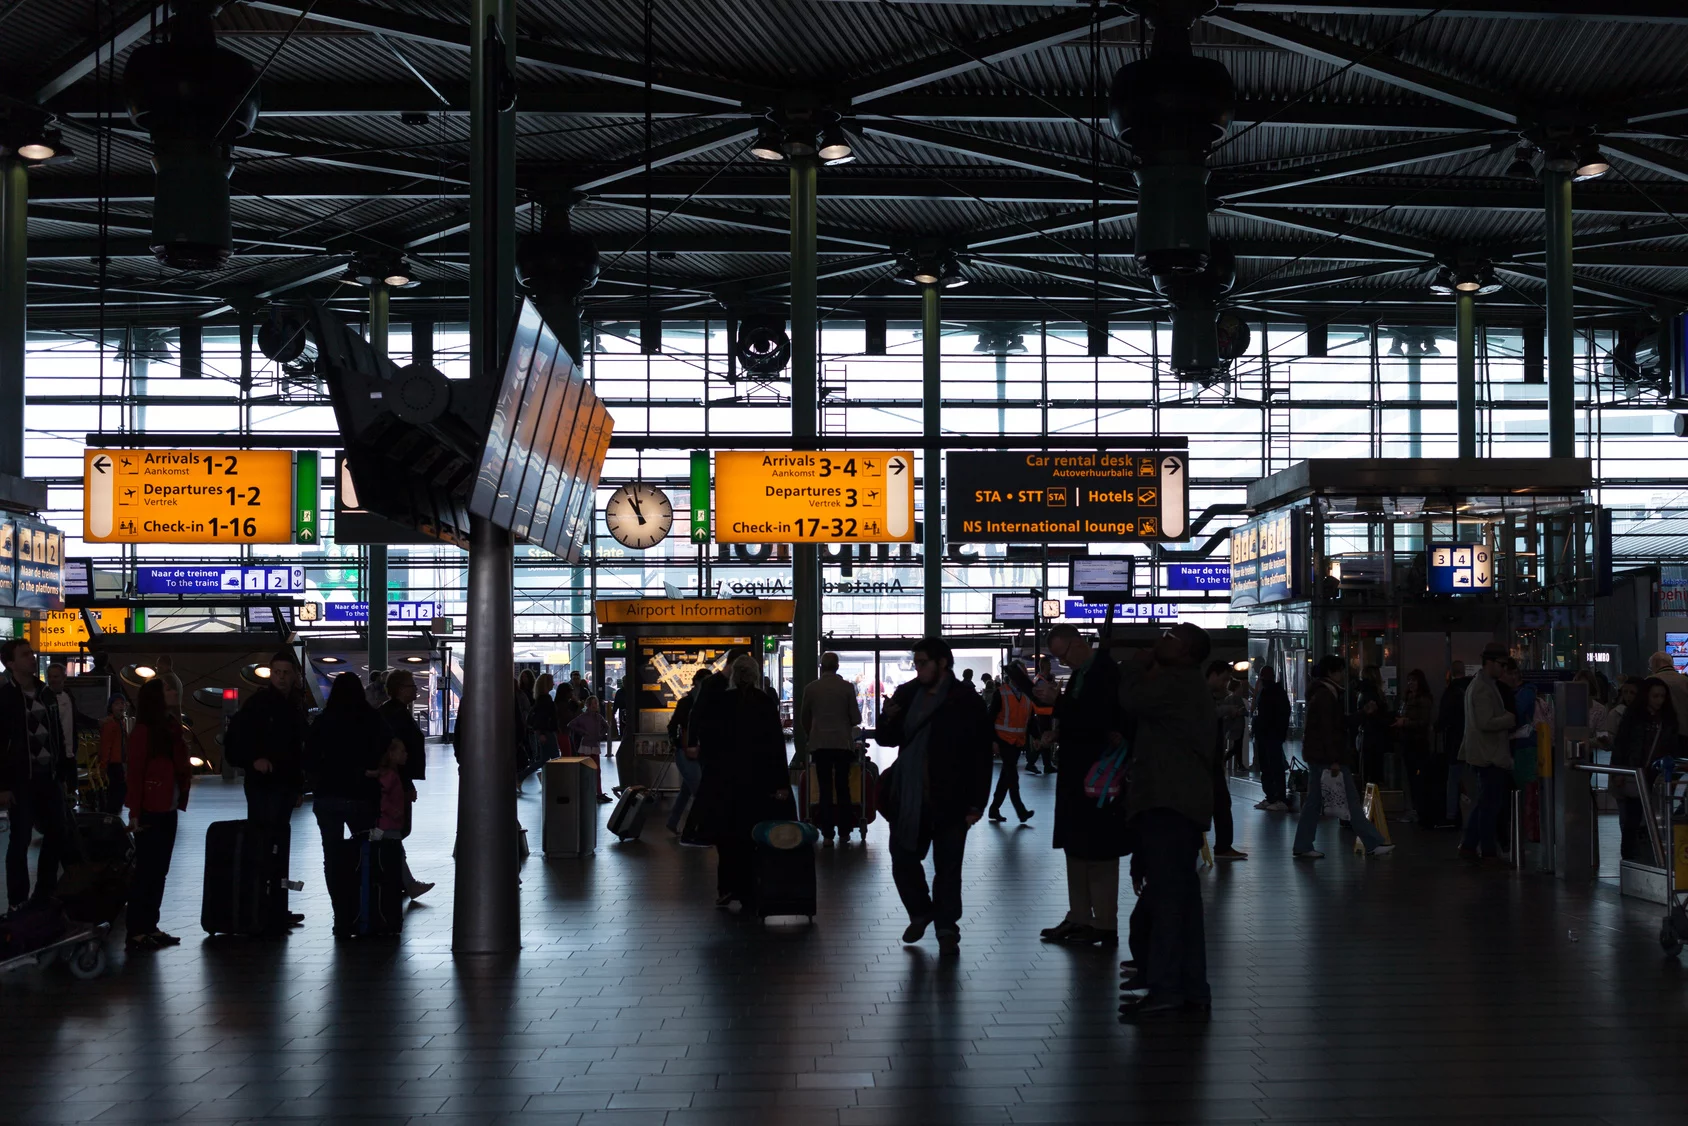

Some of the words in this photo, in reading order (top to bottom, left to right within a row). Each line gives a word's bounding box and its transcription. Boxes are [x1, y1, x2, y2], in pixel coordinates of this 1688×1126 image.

[144, 453, 200, 464] Arrivals
[203, 455, 238, 475] 1-2
[1026, 454, 1048, 467] Car
[1052, 454, 1096, 467] rental
[1101, 454, 1133, 467] desk
[144, 467, 190, 475] Aankomst
[763, 455, 816, 467] Arrivals
[819, 458, 858, 478] 3-4
[772, 468, 816, 477] Aankomst
[1053, 468, 1134, 478] Autoverhuurbalie
[144, 484, 223, 497] Departures
[226, 486, 261, 506] 1-2
[765, 485, 842, 499] Departures
[844, 488, 858, 507] 3
[975, 491, 1001, 503] STA
[1018, 491, 1043, 503] STT
[1048, 493, 1065, 501] STA
[1088, 490, 1134, 503] Hotels
[144, 498, 178, 506] Vertrek
[809, 498, 841, 508] Vertrek
[143, 520, 204, 532] Check-in
[208, 517, 257, 537] 1-16
[732, 521, 791, 533] Check-in
[794, 518, 858, 537] 17-32
[963, 521, 982, 533] NS
[987, 520, 1081, 533] International
[1085, 520, 1135, 536] lounge
[1438, 554, 1445, 565] 3
[1458, 554, 1466, 565] 4
[151, 570, 172, 578] Naar
[174, 569, 185, 578] de
[187, 569, 219, 578] treinen
[1181, 567, 1201, 575] Naar
[1202, 567, 1213, 575] de
[166, 579, 177, 587] To
[179, 579, 193, 587] the
[194, 579, 219, 587] trains
[251, 577, 258, 588] 1
[274, 577, 282, 588] 2
[1195, 576, 1205, 584] To
[1207, 576, 1220, 584] the
[406, 609, 411, 617] 1
[422, 609, 429, 617] 2
[626, 602, 676, 619] Airport
[681, 602, 763, 617] Information
[1142, 606, 1148, 615] 3
[1158, 606, 1164, 615] 4
